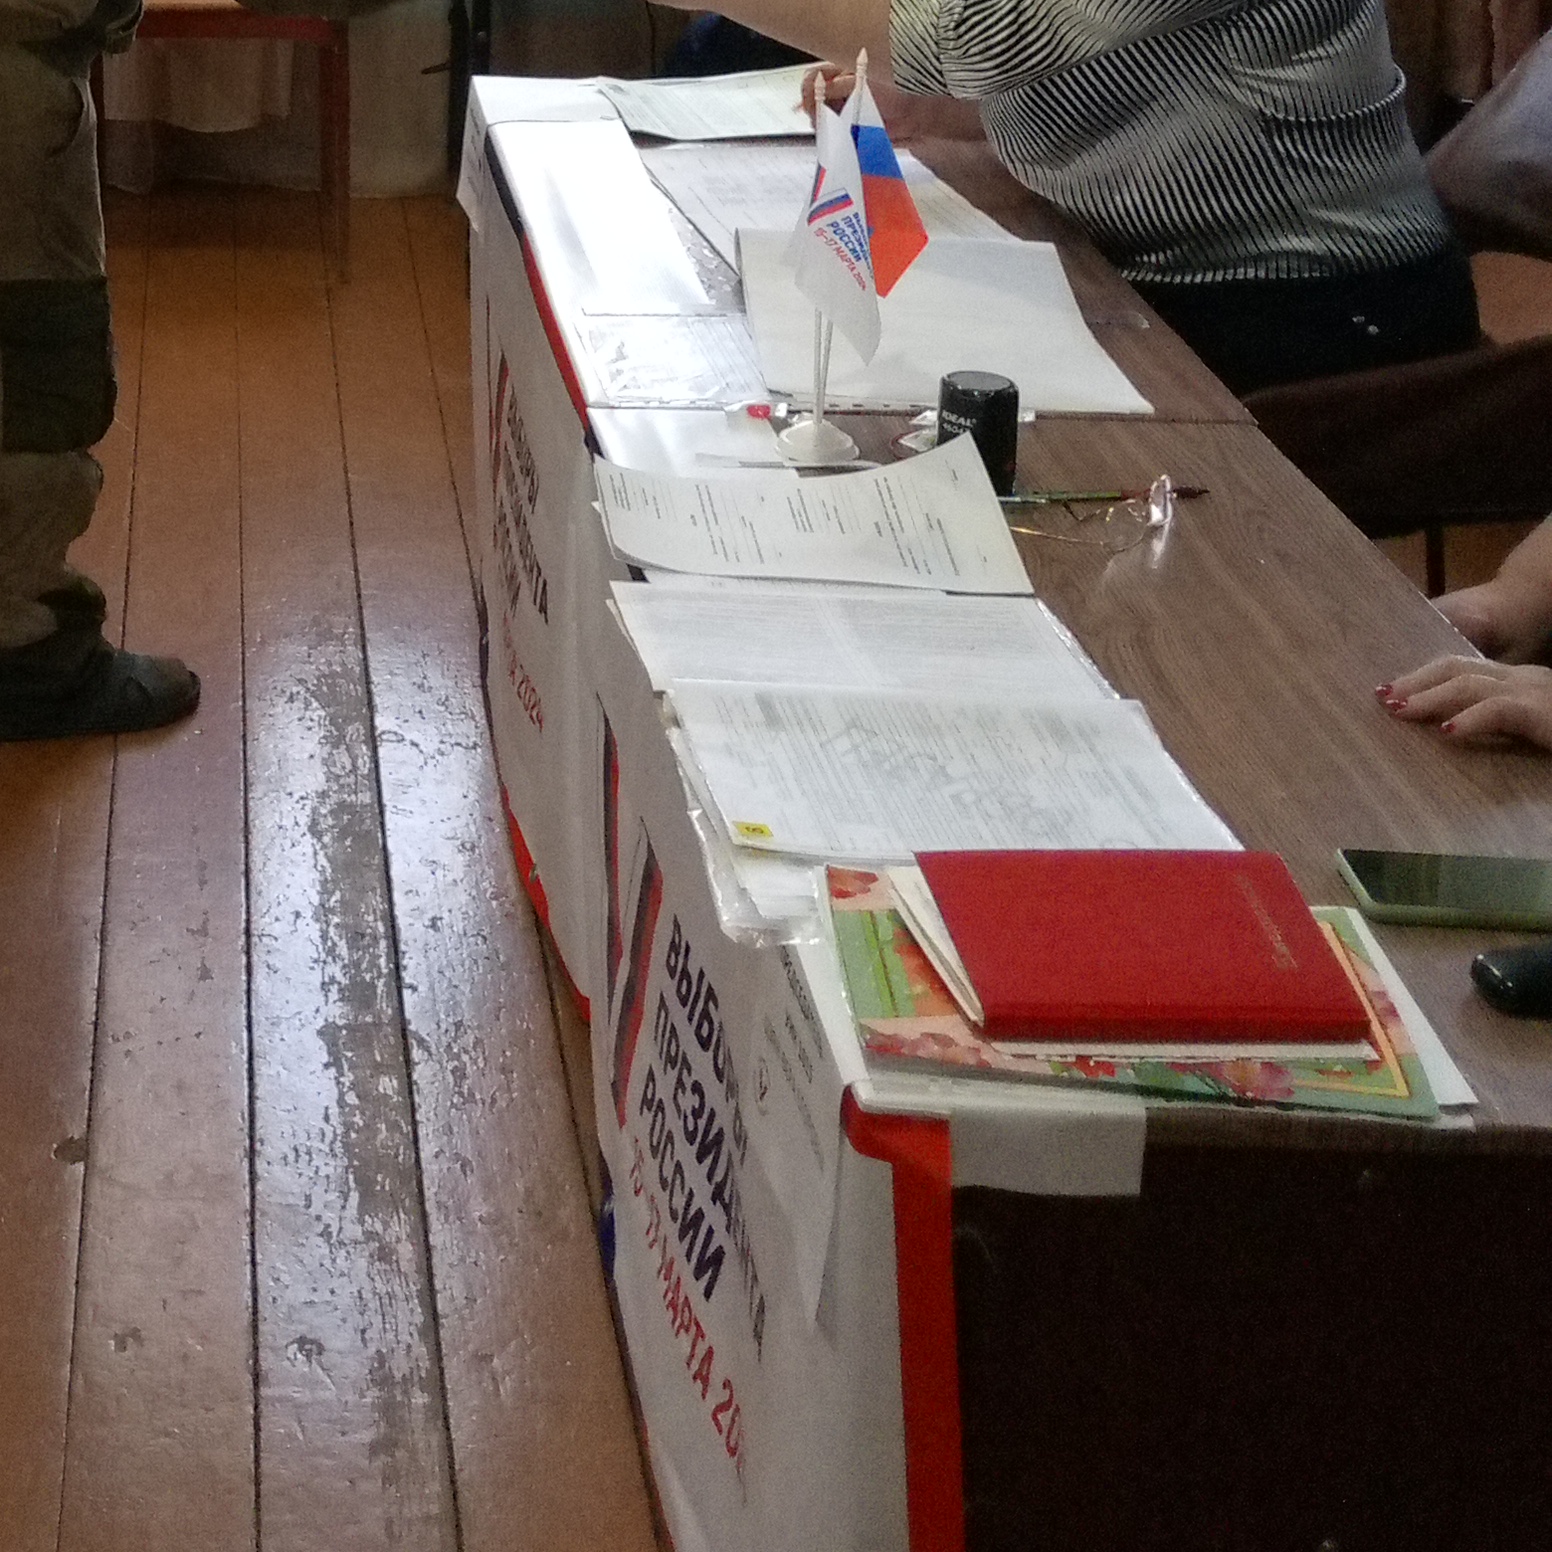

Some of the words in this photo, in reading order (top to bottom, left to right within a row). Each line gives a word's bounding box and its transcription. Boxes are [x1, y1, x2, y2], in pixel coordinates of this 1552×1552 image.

[826, 220, 862, 263] РОССИИ
[640, 1063, 726, 1302] РОССИИ
[657, 1234, 715, 1401] МАРТА
